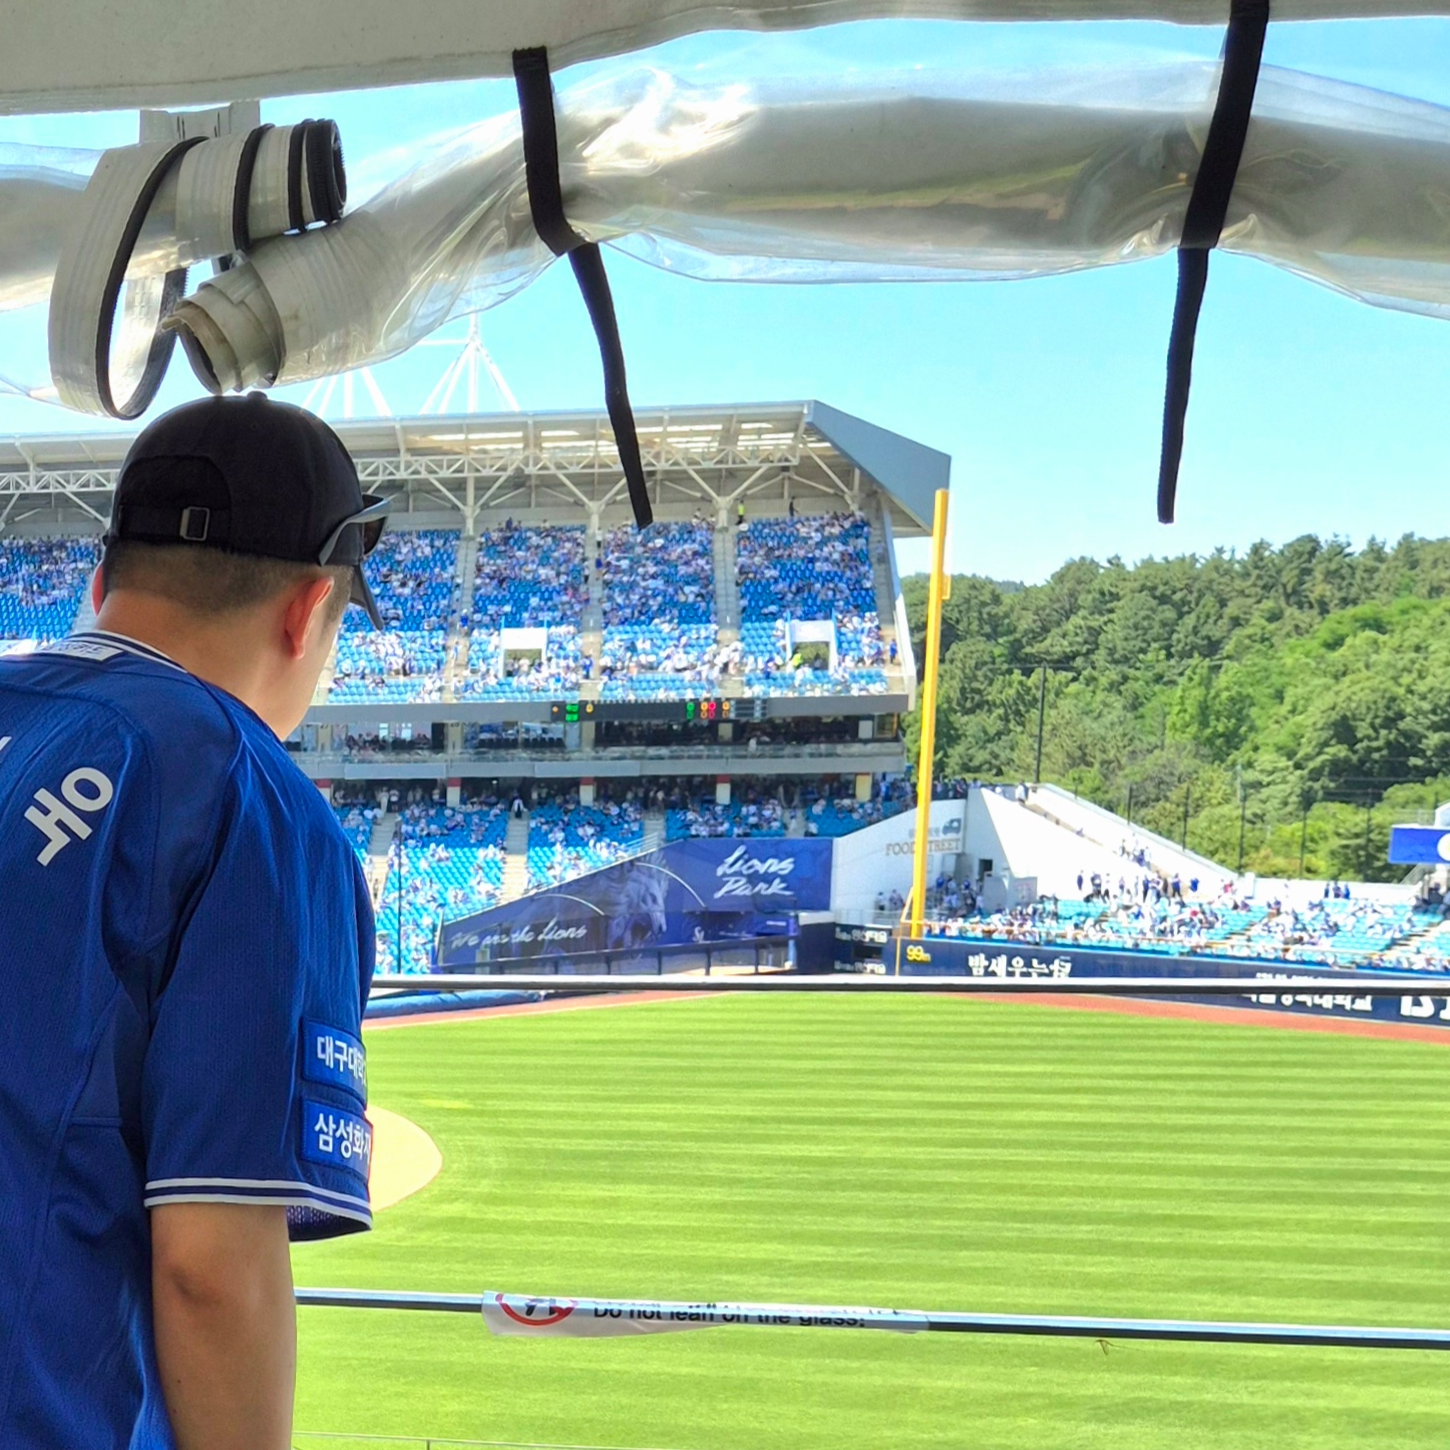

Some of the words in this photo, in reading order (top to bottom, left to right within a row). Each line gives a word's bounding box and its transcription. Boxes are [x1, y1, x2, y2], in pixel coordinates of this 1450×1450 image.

[927, 838, 961, 852] TREET
[716, 845, 795, 877] Lions
[713, 876, 795, 899] Park
[537, 916, 588, 942] Lions
